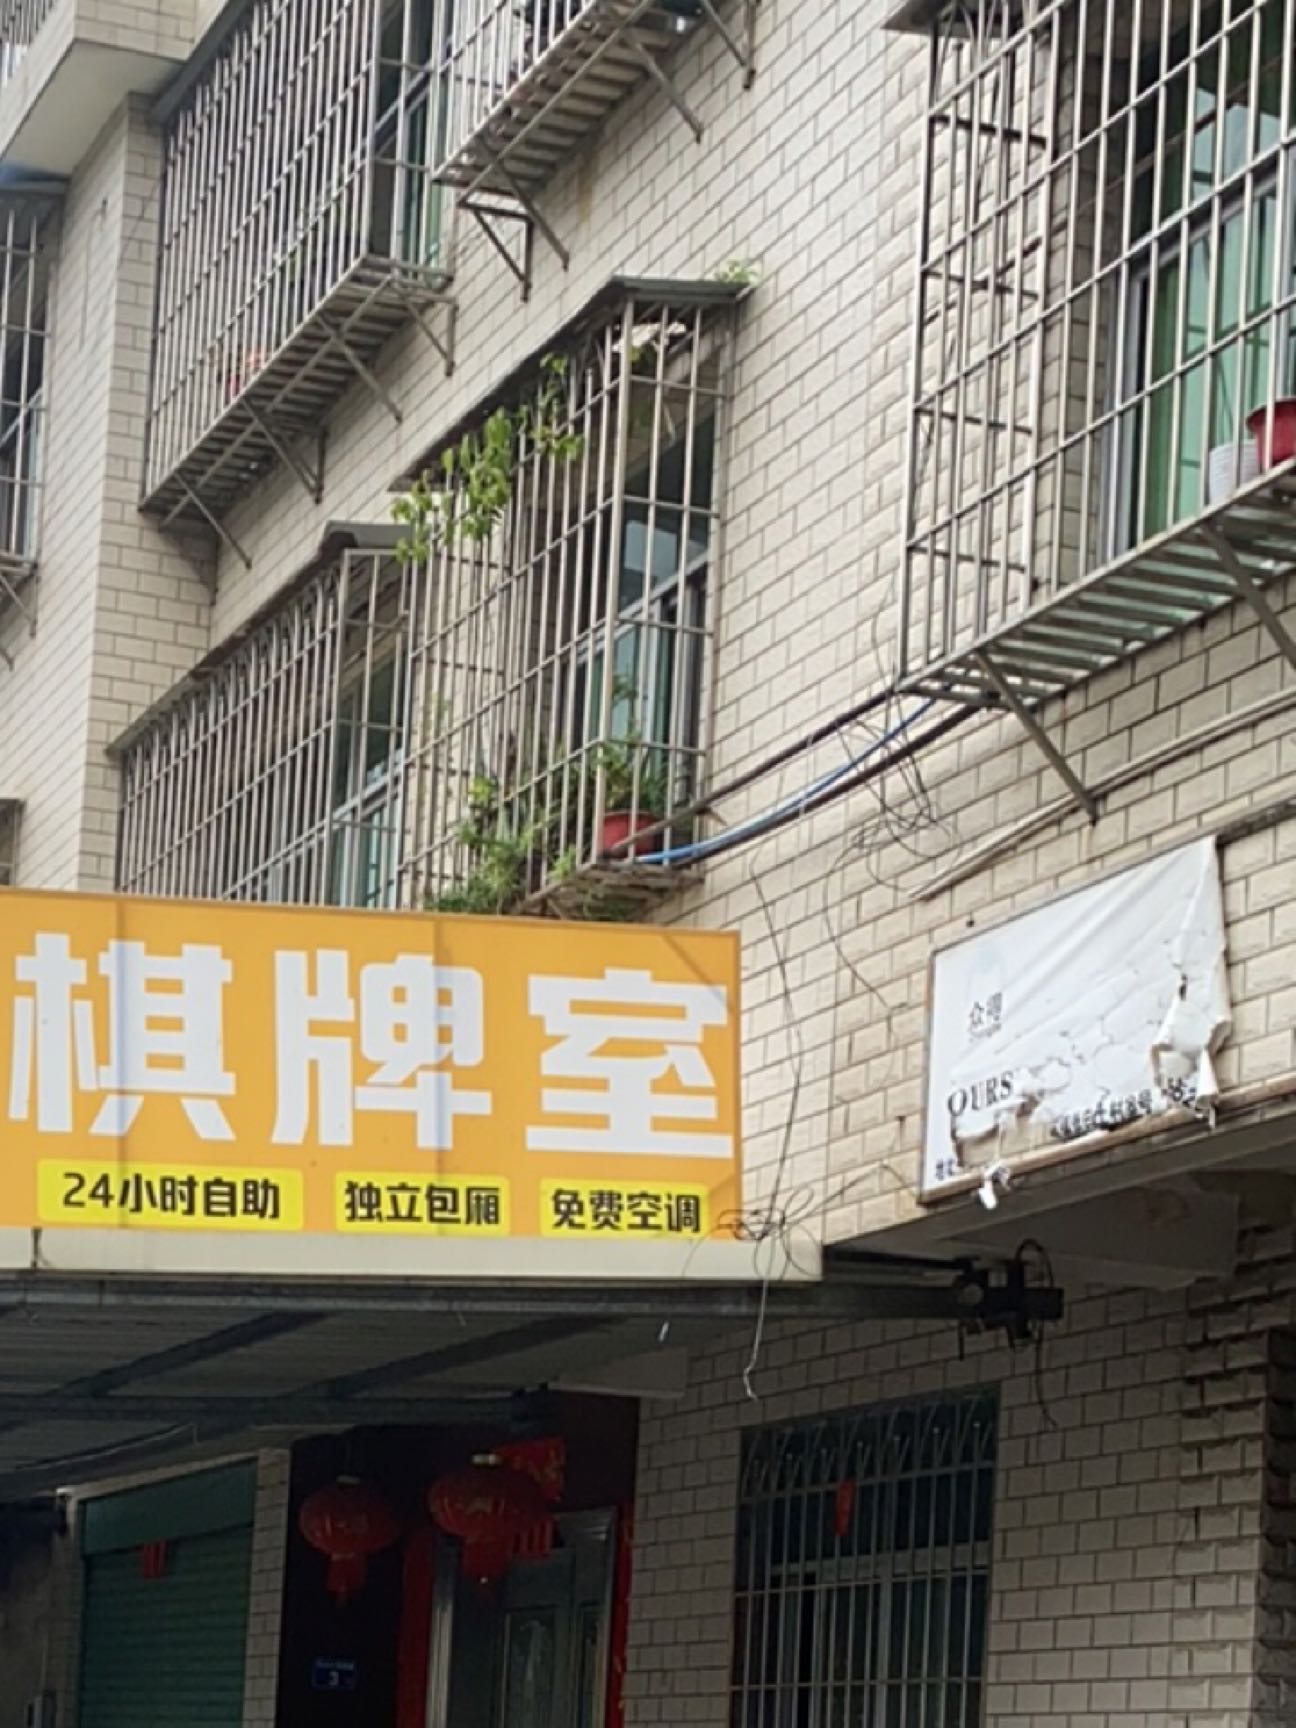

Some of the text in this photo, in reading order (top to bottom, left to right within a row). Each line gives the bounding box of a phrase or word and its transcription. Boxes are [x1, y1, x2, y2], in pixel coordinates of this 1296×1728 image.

[9, 932, 735, 1160] 棋牌室
[62, 1172, 280, 1220] 24小时自助
[344, 1180, 501, 1225] 独立包厢
[551, 1188, 701, 1234] 免费空调
